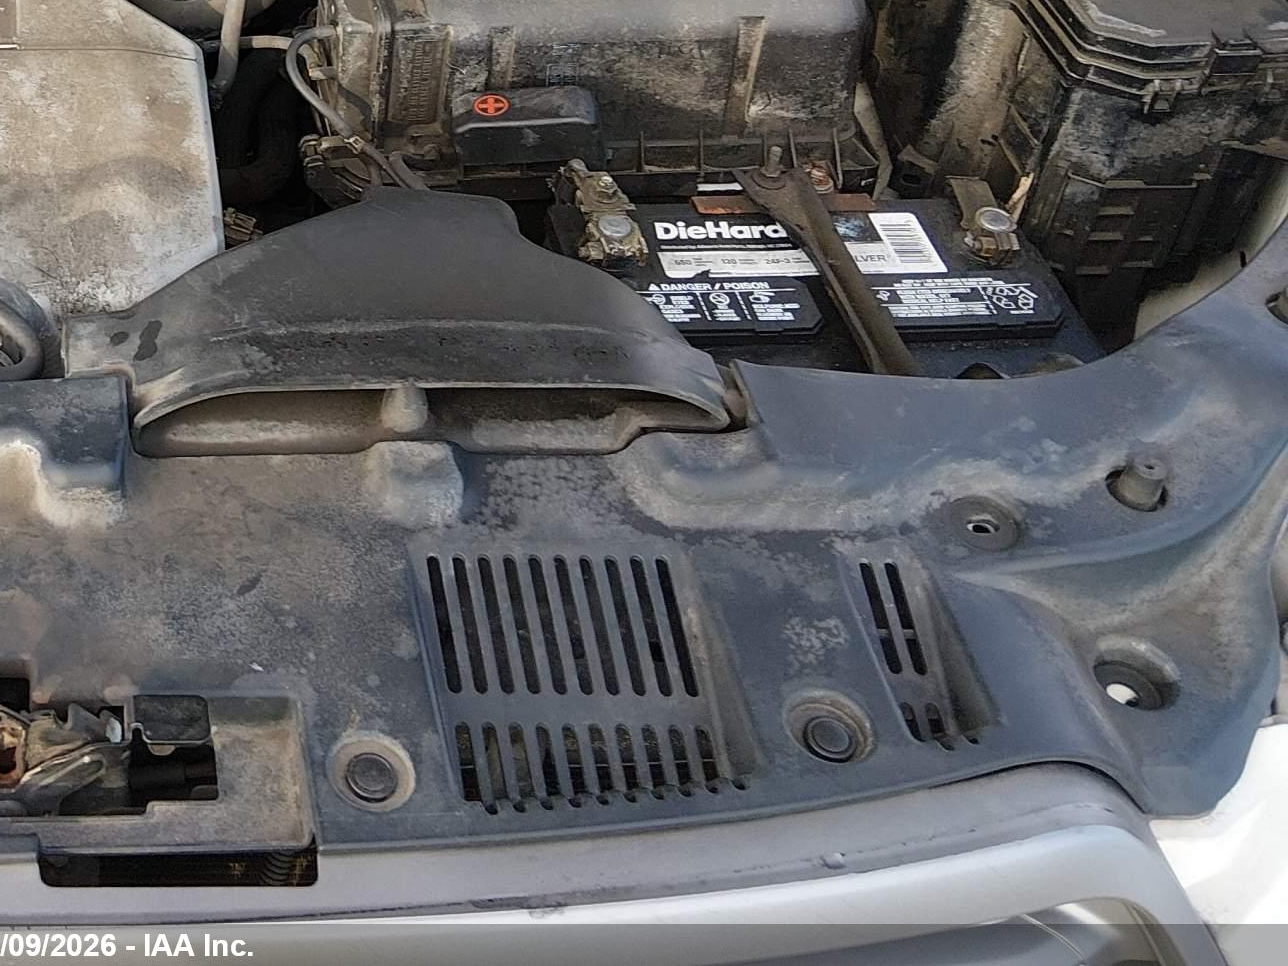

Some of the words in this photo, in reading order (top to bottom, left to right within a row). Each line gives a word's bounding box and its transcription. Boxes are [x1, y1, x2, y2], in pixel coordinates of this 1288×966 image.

[653, 220, 789, 241] DieHard
[854, 254, 887, 263] LVER
[659, 283, 712, 291] DANGER
[722, 281, 770, 290] POISON
